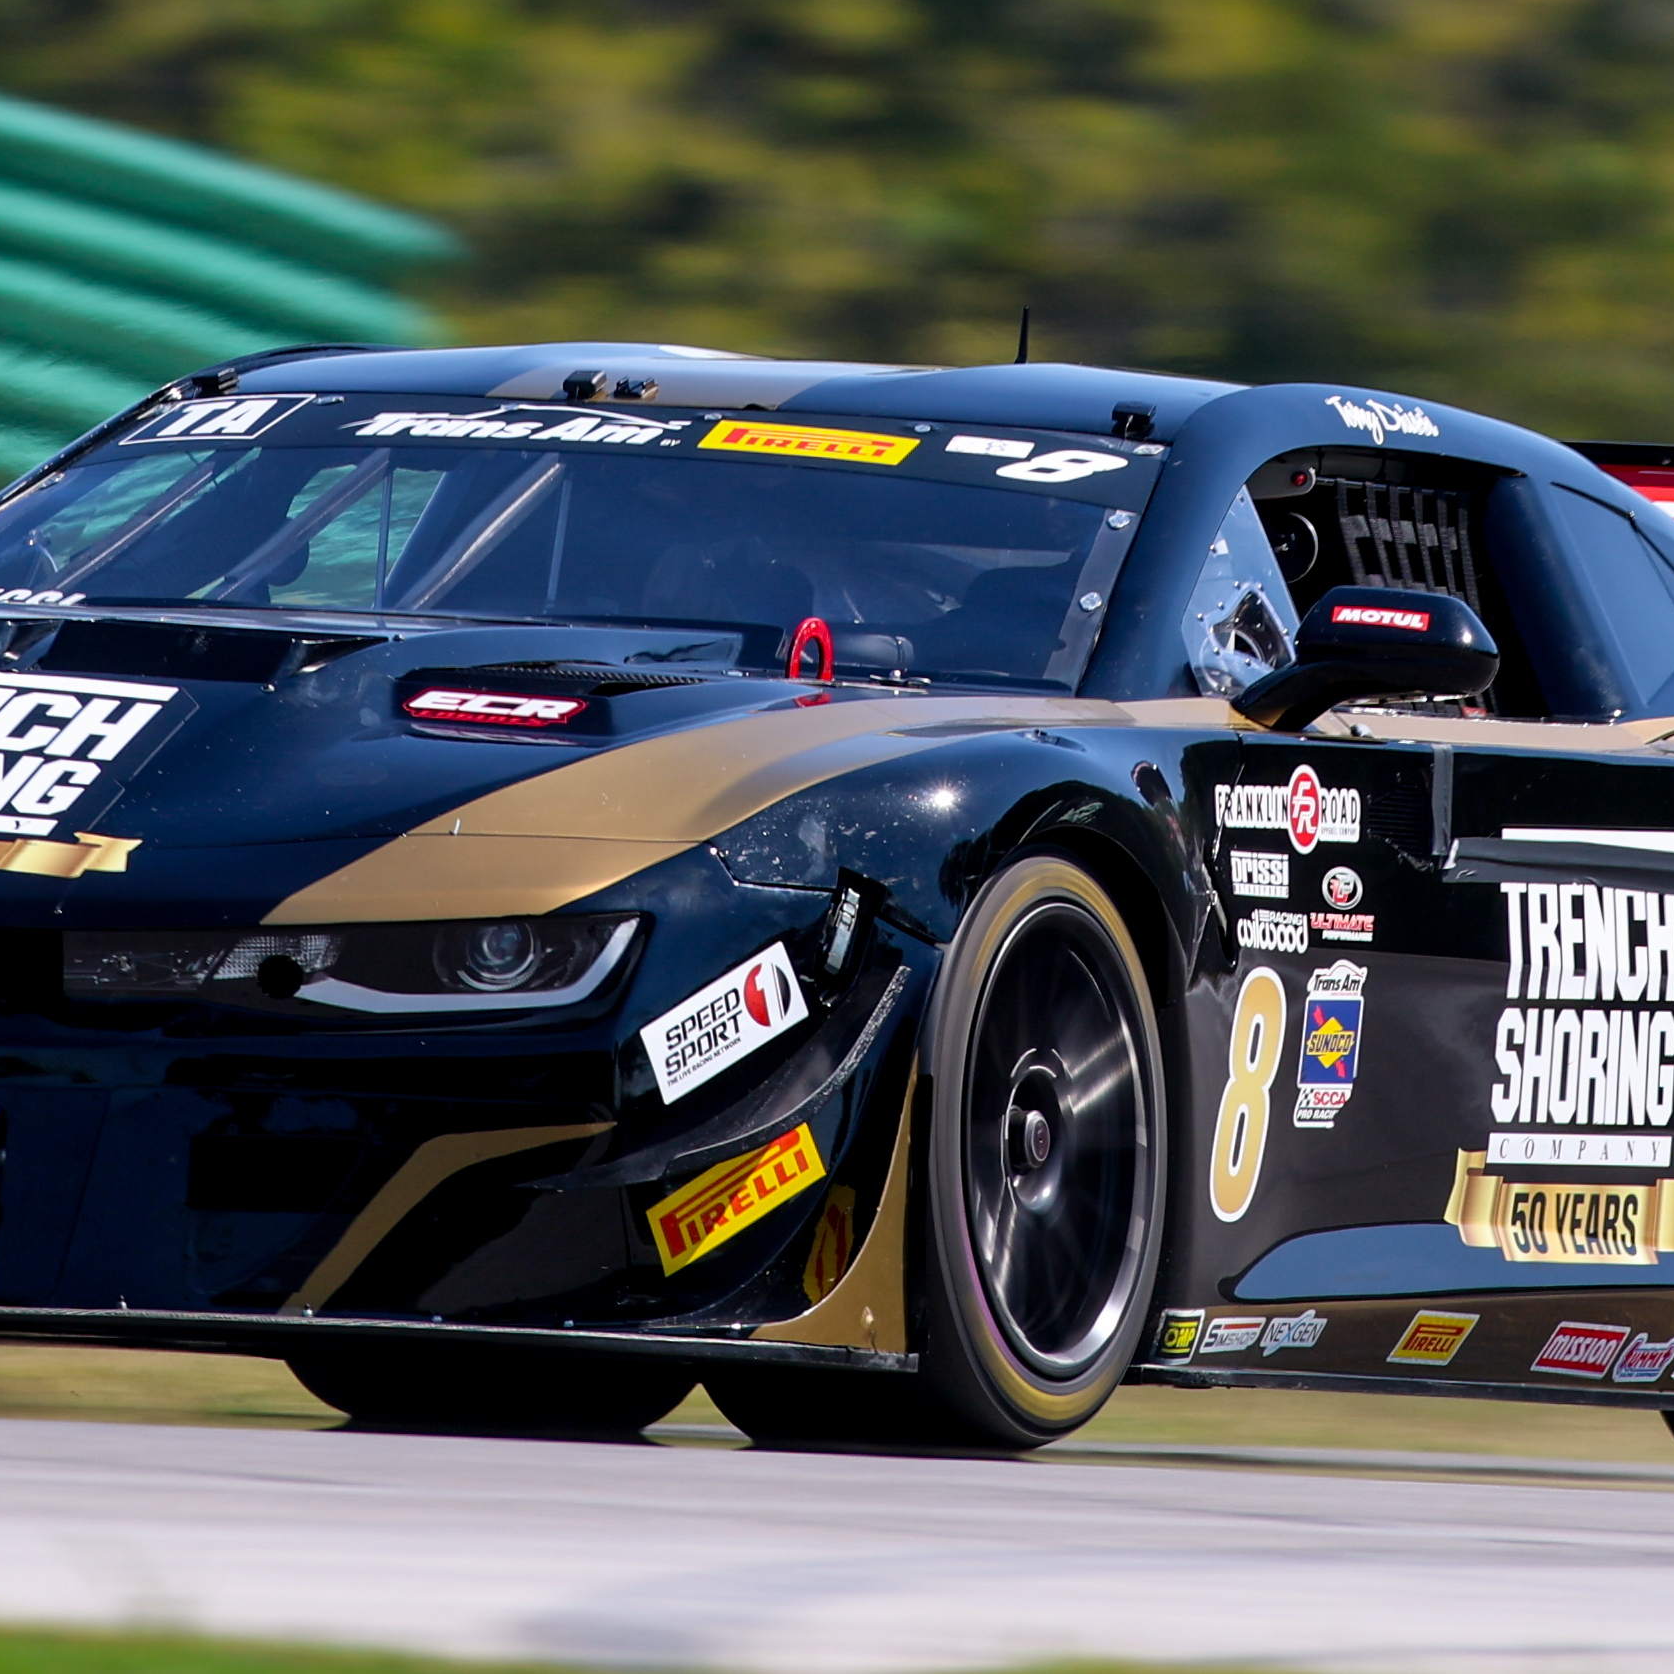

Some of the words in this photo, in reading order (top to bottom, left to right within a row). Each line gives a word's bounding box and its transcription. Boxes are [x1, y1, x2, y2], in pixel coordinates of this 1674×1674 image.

[157, 399, 278, 436] TA
[356, 412, 543, 438] Trans
[529, 417, 663, 445] Am
[720, 428, 895, 457] PIRELLI
[996, 450, 1128, 483] 8
[1337, 608, 1424, 628] MOTUL
[409, 690, 578, 718] ECR
[1218, 787, 1289, 824] FRANKLIN
[1320, 790, 1358, 824] ROAD
[1270, 910, 1303, 926] RACING
[1310, 912, 1374, 931] ULTIMATE
[1313, 974, 1340, 992] Trans
[1342, 974, 1361, 991] Am
[666, 988, 740, 1051] SPEED
[665, 1010, 743, 1077] SPORT
[1309, 1034, 1352, 1053] SUNOCO
[679, 1067, 692, 1081] LIVE
[692, 1054, 713, 1072] RACING
[1210, 966, 1287, 1222] 8
[1313, 1092, 1347, 1105] SCCA
[1296, 1109, 1312, 1119] PRO
[1500, 1138, 1661, 1162] COMPANY
[659, 1129, 810, 1258] PIRELLI
[1511, 1192, 1546, 1254] 50
[1555, 1192, 1639, 1257] YEARS
[1164, 1328, 1195, 1348] OMP
[1402, 1323, 1464, 1352] PIRELLI
